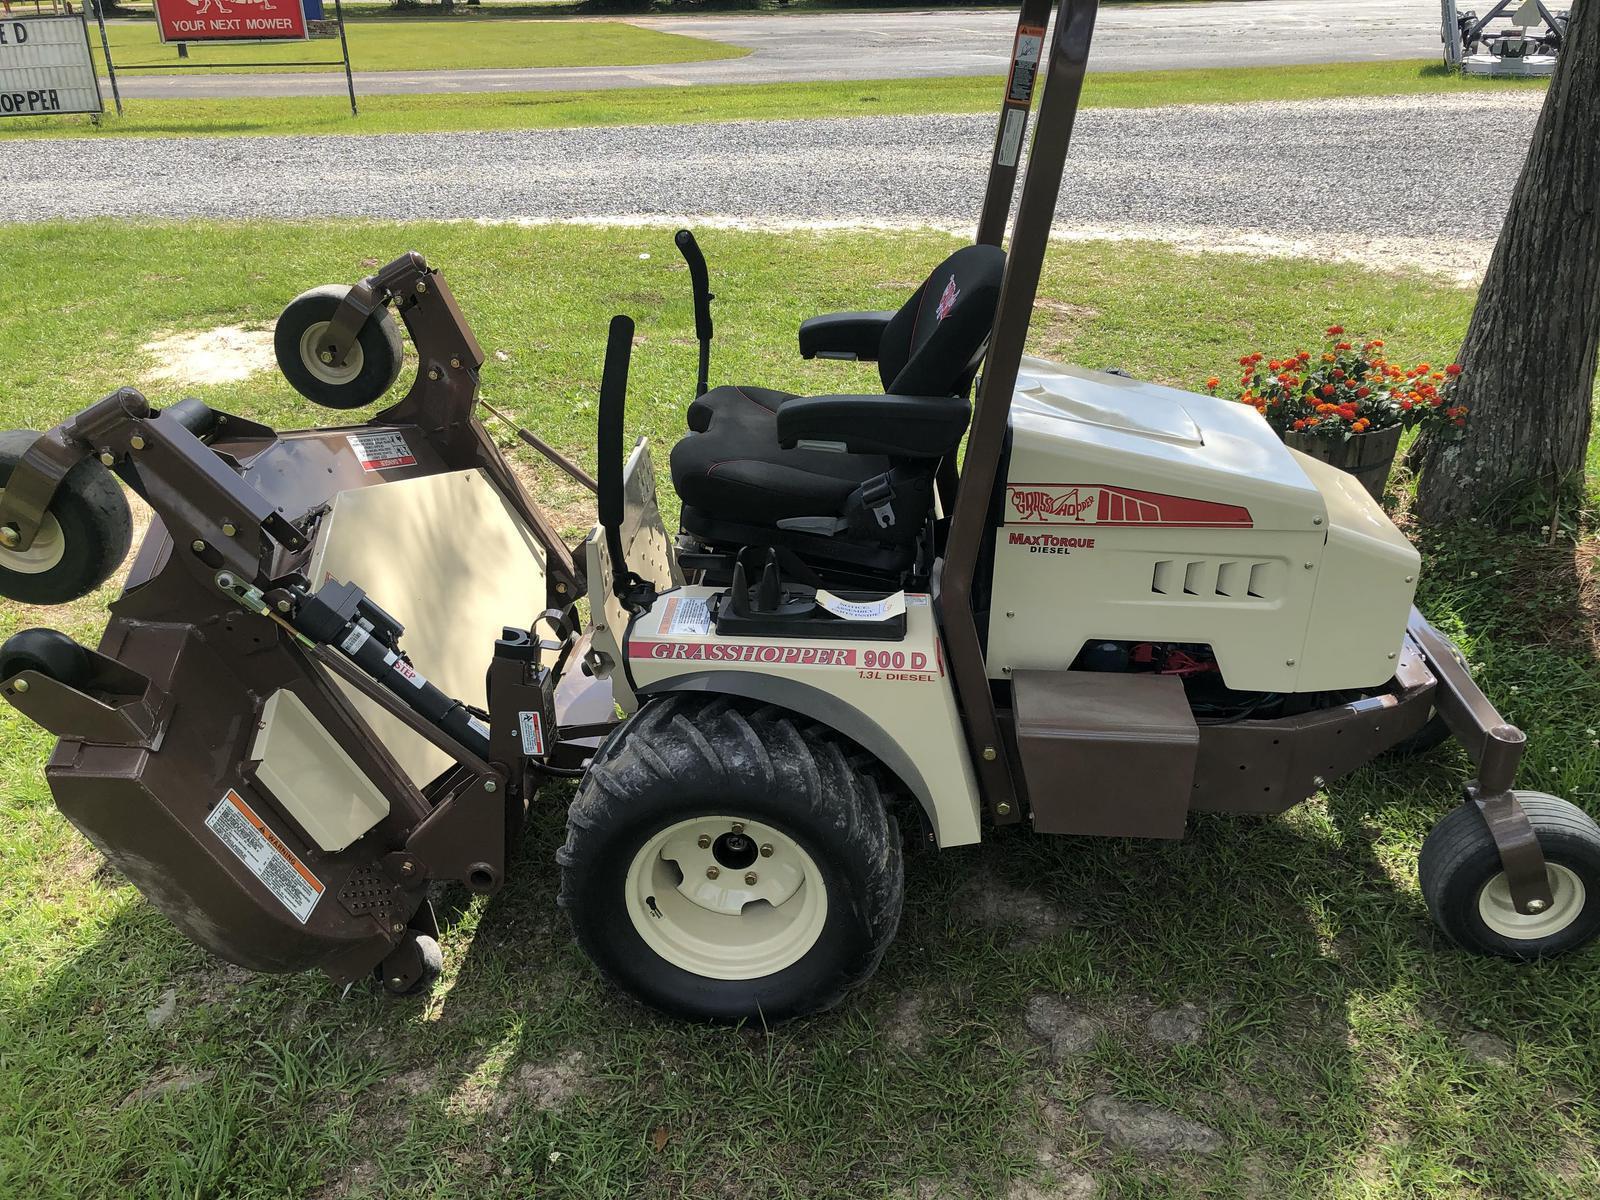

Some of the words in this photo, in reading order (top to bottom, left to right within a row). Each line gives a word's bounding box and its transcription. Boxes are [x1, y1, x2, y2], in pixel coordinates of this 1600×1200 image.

[172, 20, 206, 31] YOUR
[210, 19, 240, 30] NEXT
[246, 18, 293, 29] MOWER
[0, 89, 60, 113] OPPER
[1030, 546, 1071, 555] DIESEL
[651, 643, 848, 665] GRASSHOPPER
[864, 650, 905, 669] 900
[911, 652, 927, 669] D
[394, 661, 416, 679] STEP
[886, 673, 935, 682] DIESEL
[268, 833, 297, 865] WARNING
